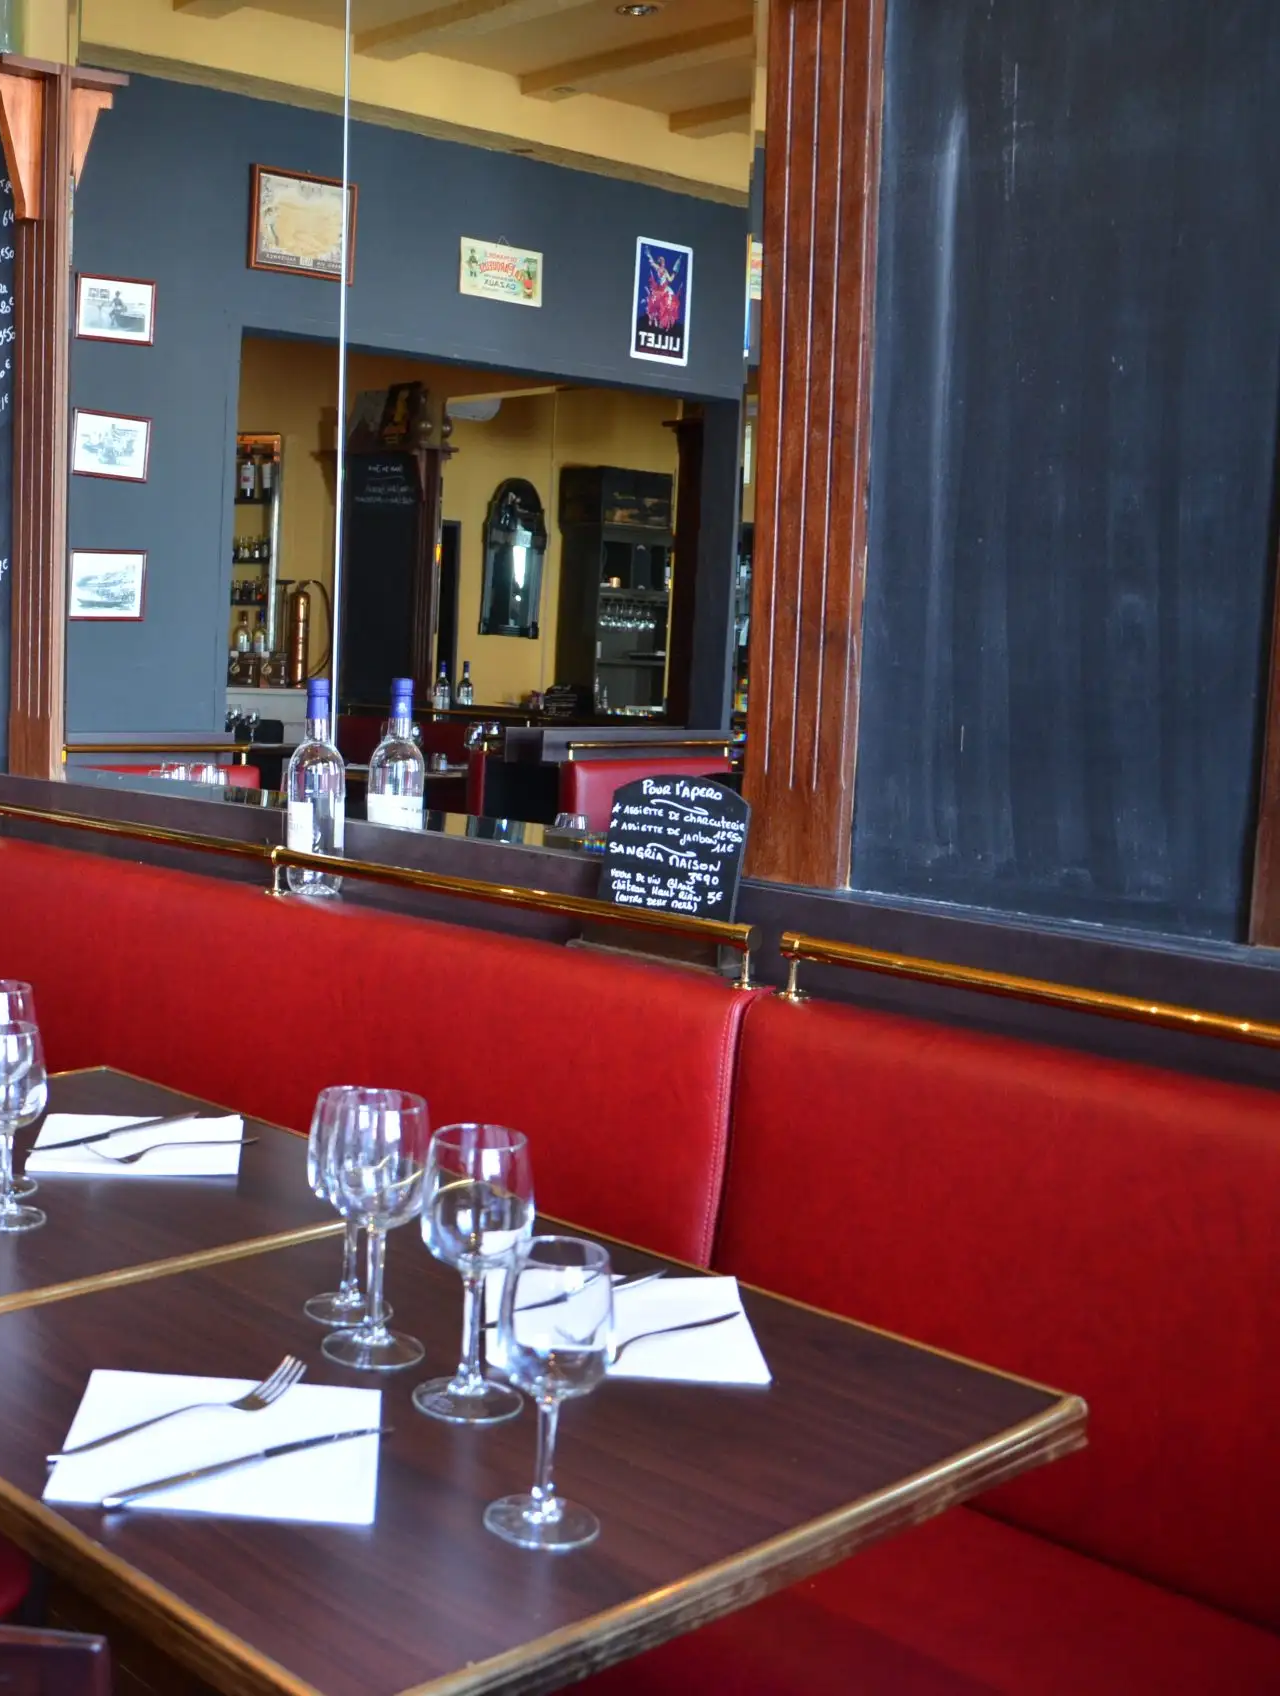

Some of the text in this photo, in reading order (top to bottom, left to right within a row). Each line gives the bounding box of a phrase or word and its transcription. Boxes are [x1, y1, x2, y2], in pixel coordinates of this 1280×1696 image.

[642, 779, 671, 795] POUR
[668, 811, 680, 821] DE
[667, 828, 680, 836] DE
[707, 891, 723, 905] 5€
